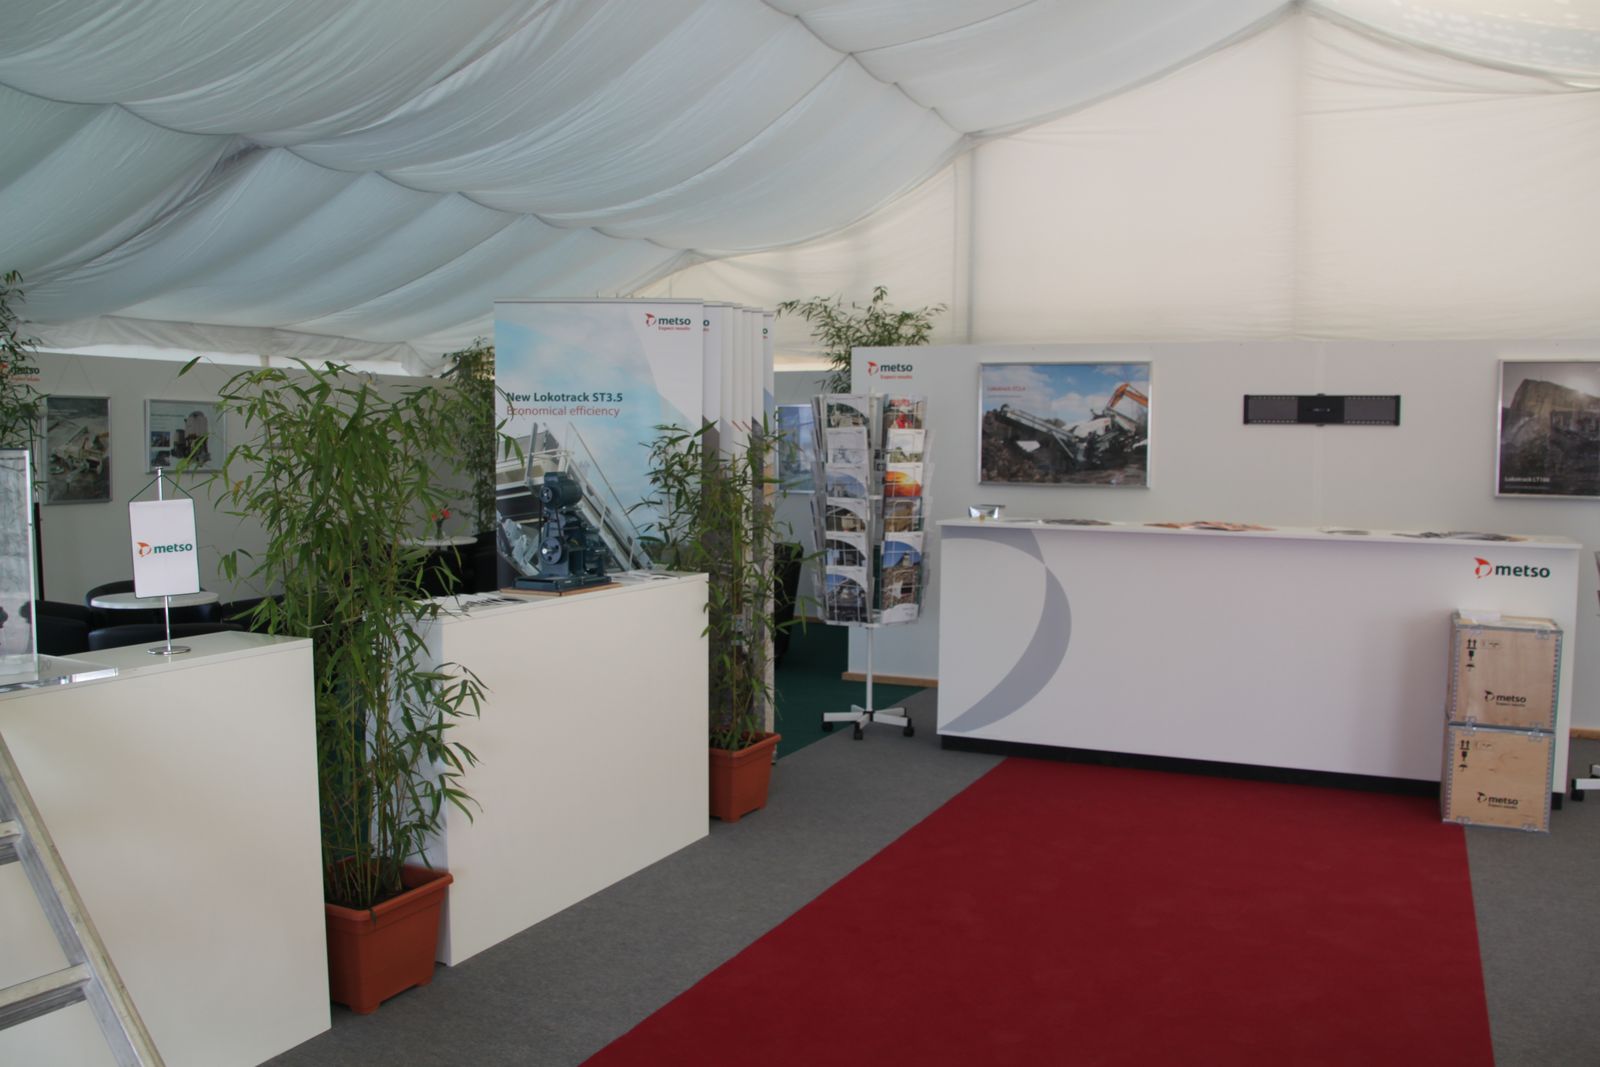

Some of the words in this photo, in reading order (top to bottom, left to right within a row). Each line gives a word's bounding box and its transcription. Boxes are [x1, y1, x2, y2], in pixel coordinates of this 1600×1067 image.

[657, 316, 692, 326] metso
[880, 363, 913, 373] metso
[506, 392, 531, 402] New
[533, 392, 590, 402] Lokotrack
[592, 392, 624, 402] ST3.5
[506, 406, 567, 416] Economical
[569, 406, 620, 418] efficiency
[153, 543, 193, 554] metso
[1495, 565, 1551, 578] metso
[1496, 695, 1527, 703] metso
[1488, 796, 1519, 806] metso
